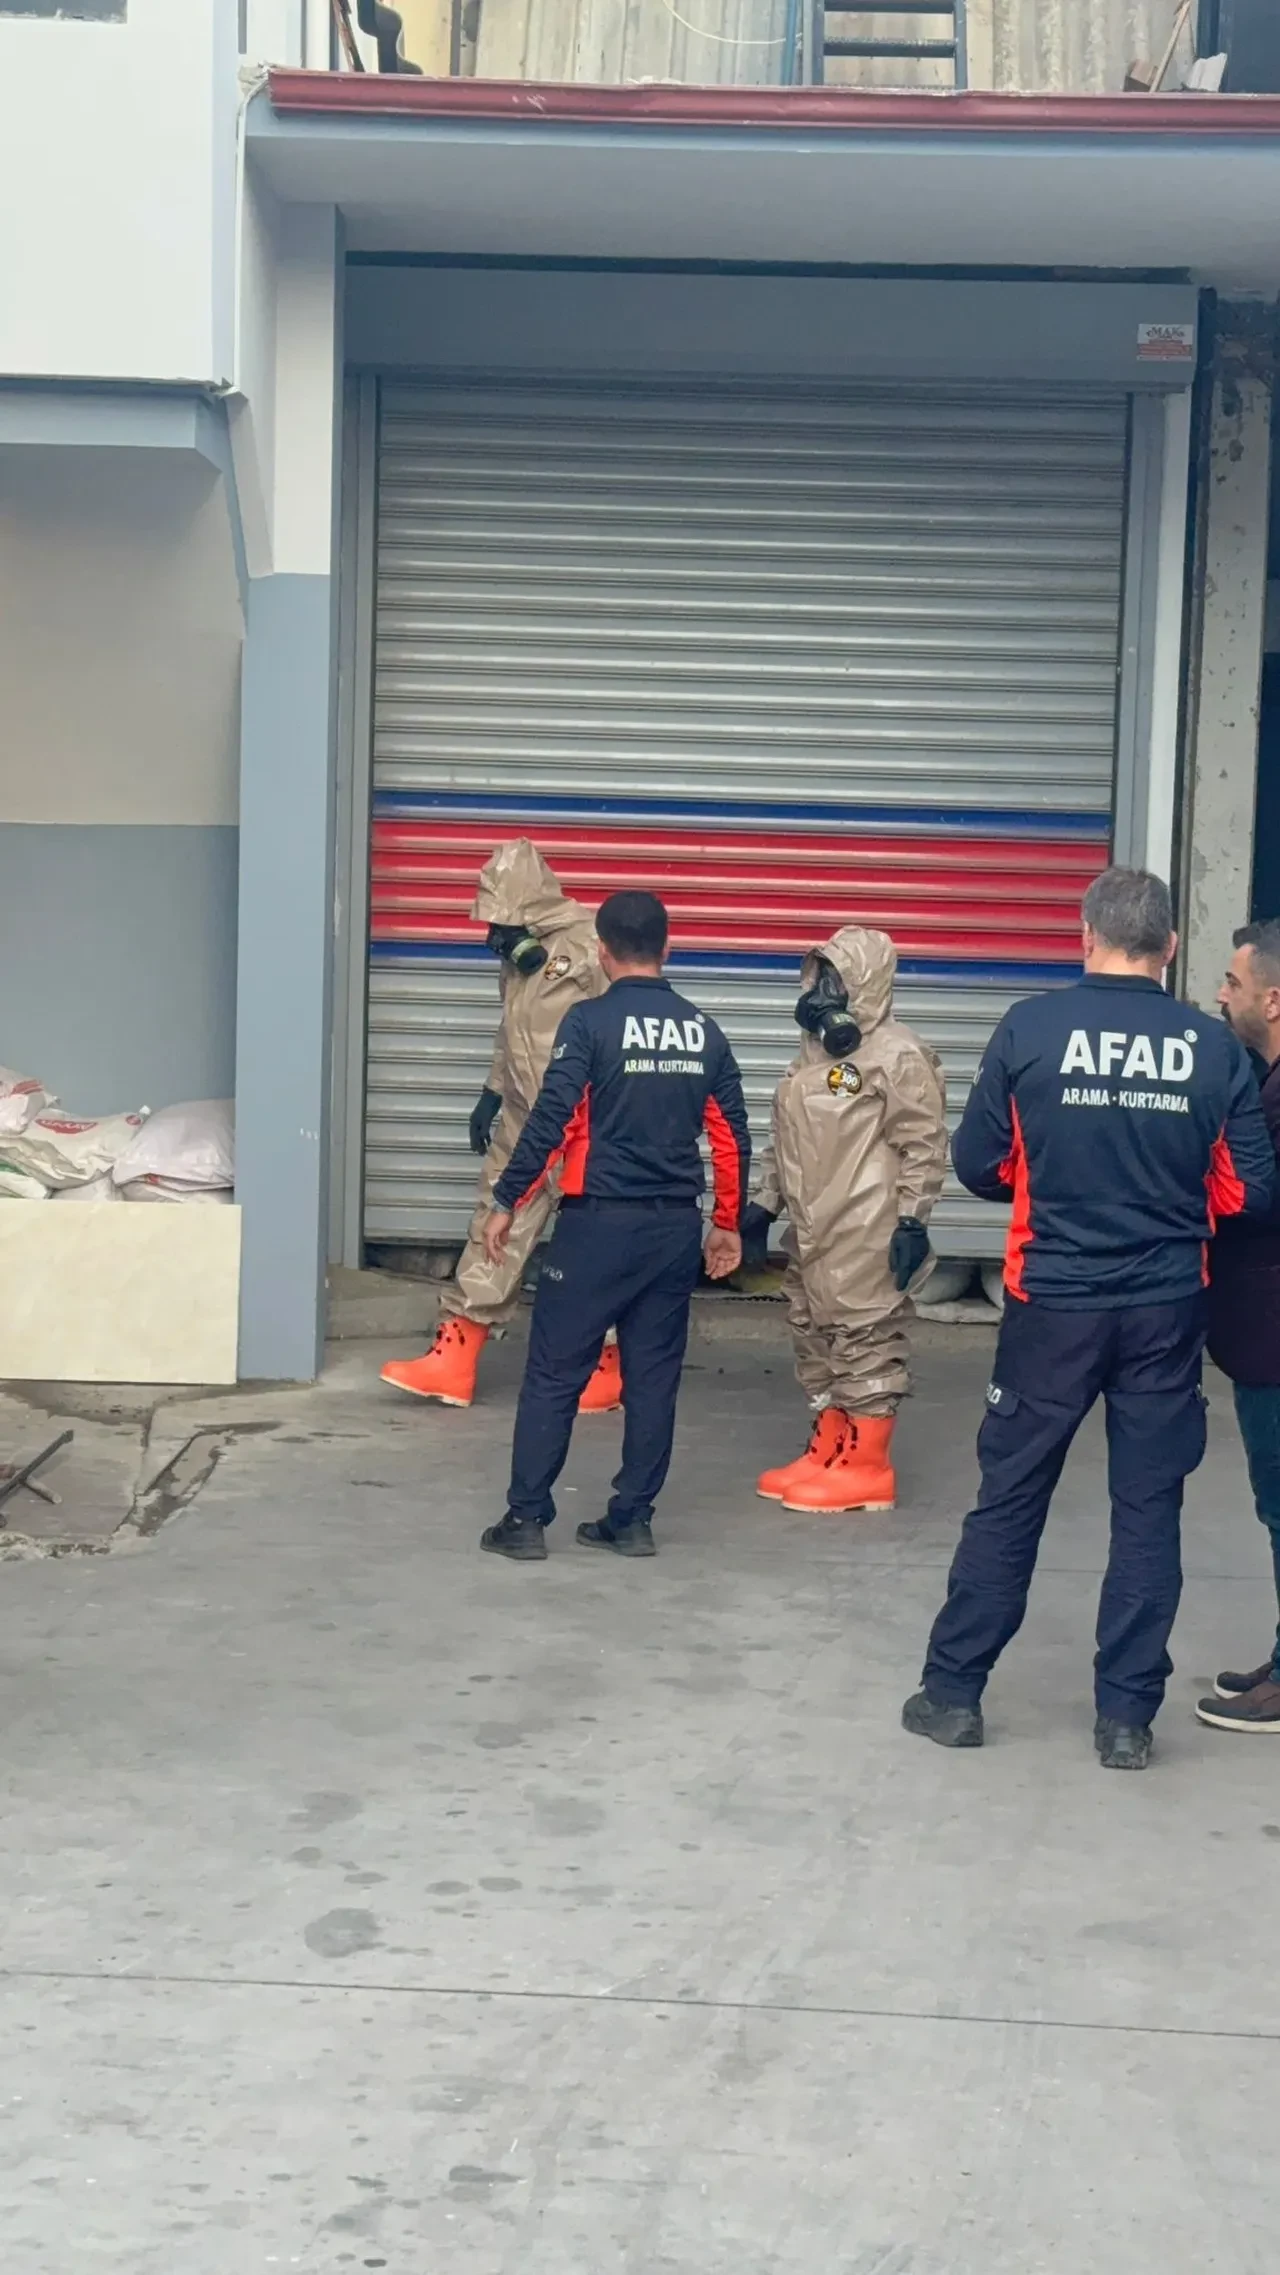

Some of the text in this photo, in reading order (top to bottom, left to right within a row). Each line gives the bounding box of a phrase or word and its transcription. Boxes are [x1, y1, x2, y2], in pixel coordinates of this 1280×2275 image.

[623, 1059, 704, 1075] ARAMA KURTARMA
[1061, 1087, 1190, 1113] ARAMA KURTARMA
